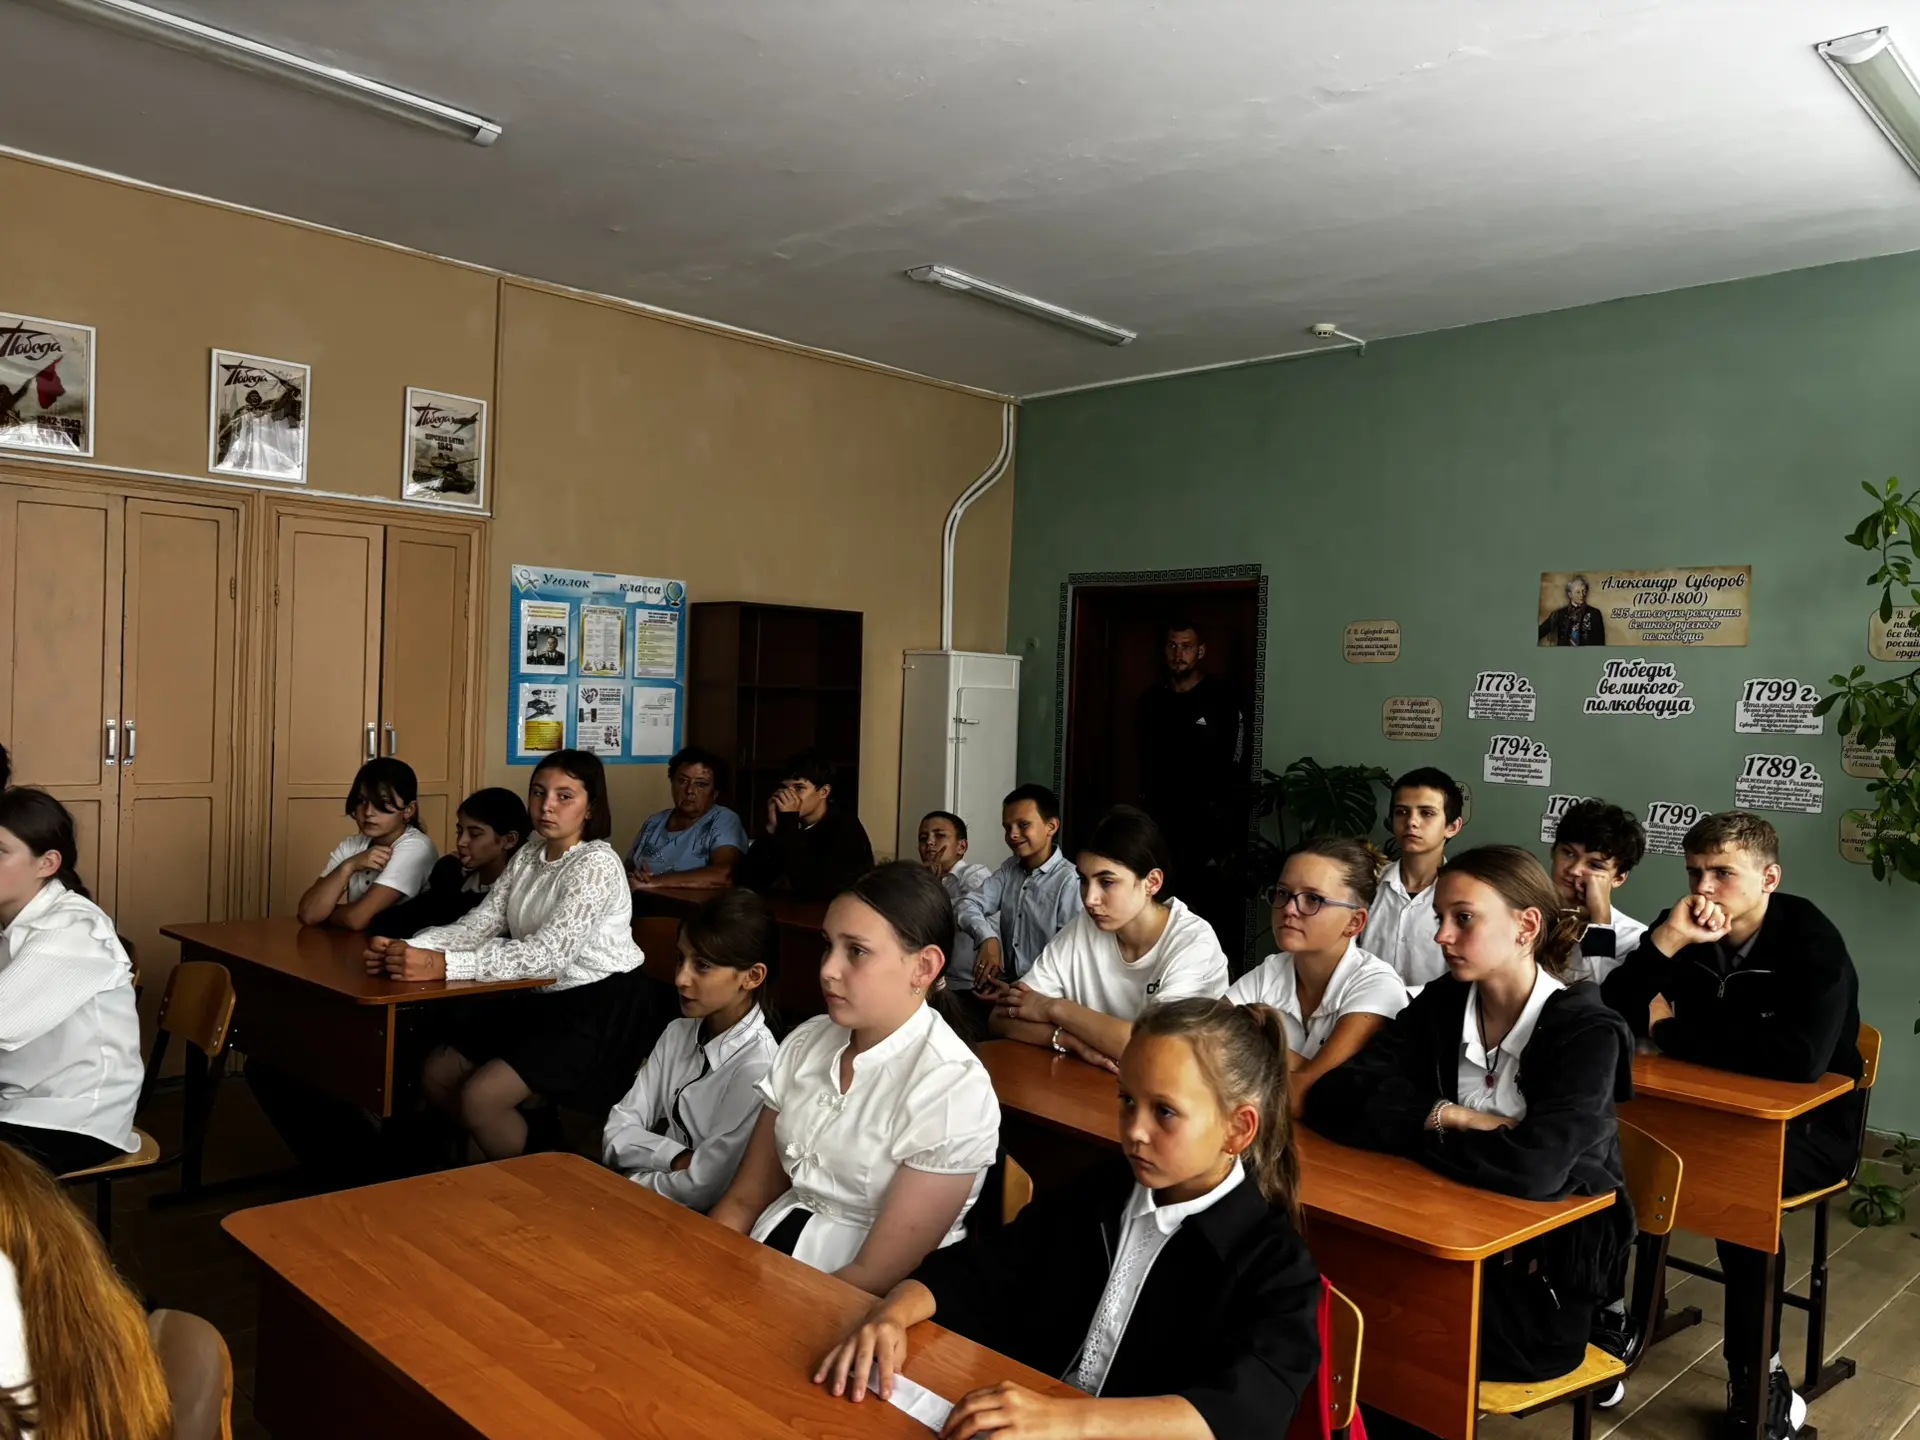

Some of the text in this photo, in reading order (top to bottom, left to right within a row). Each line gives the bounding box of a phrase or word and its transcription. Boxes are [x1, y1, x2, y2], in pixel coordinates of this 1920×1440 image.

[0, 320, 62, 361] Победа
[220, 360, 268, 388] Победа
[412, 402, 452, 428] Победа
[437, 442, 453, 452] 1943
[543, 574, 661, 594] Уголок класса
[1601, 572, 1746, 592] Александр Суворов
[1633, 591, 1709, 607] (1730-1800)
[1610, 608, 1630, 618] 295
[1630, 610, 1651, 618] лет
[1664, 610, 1685, 620] дня
[1686, 608, 1742, 620] рождения
[1629, 619, 1722, 632] великого русского
[1886, 629, 1902, 638] все
[1643, 631, 1704, 643] полководца
[1886, 639, 1920, 650] россий
[1606, 661, 1673, 682] Победы
[1477, 673, 1531, 692] 1773 г.
[1599, 678, 1681, 694] великого
[1745, 681, 1818, 702] 1799 г.
[1585, 695, 1692, 716] полководца
[1491, 737, 1548, 757] 1794 г.
[1746, 757, 1818, 780] 1789 г.
[1650, 804, 1697, 825] 1799
